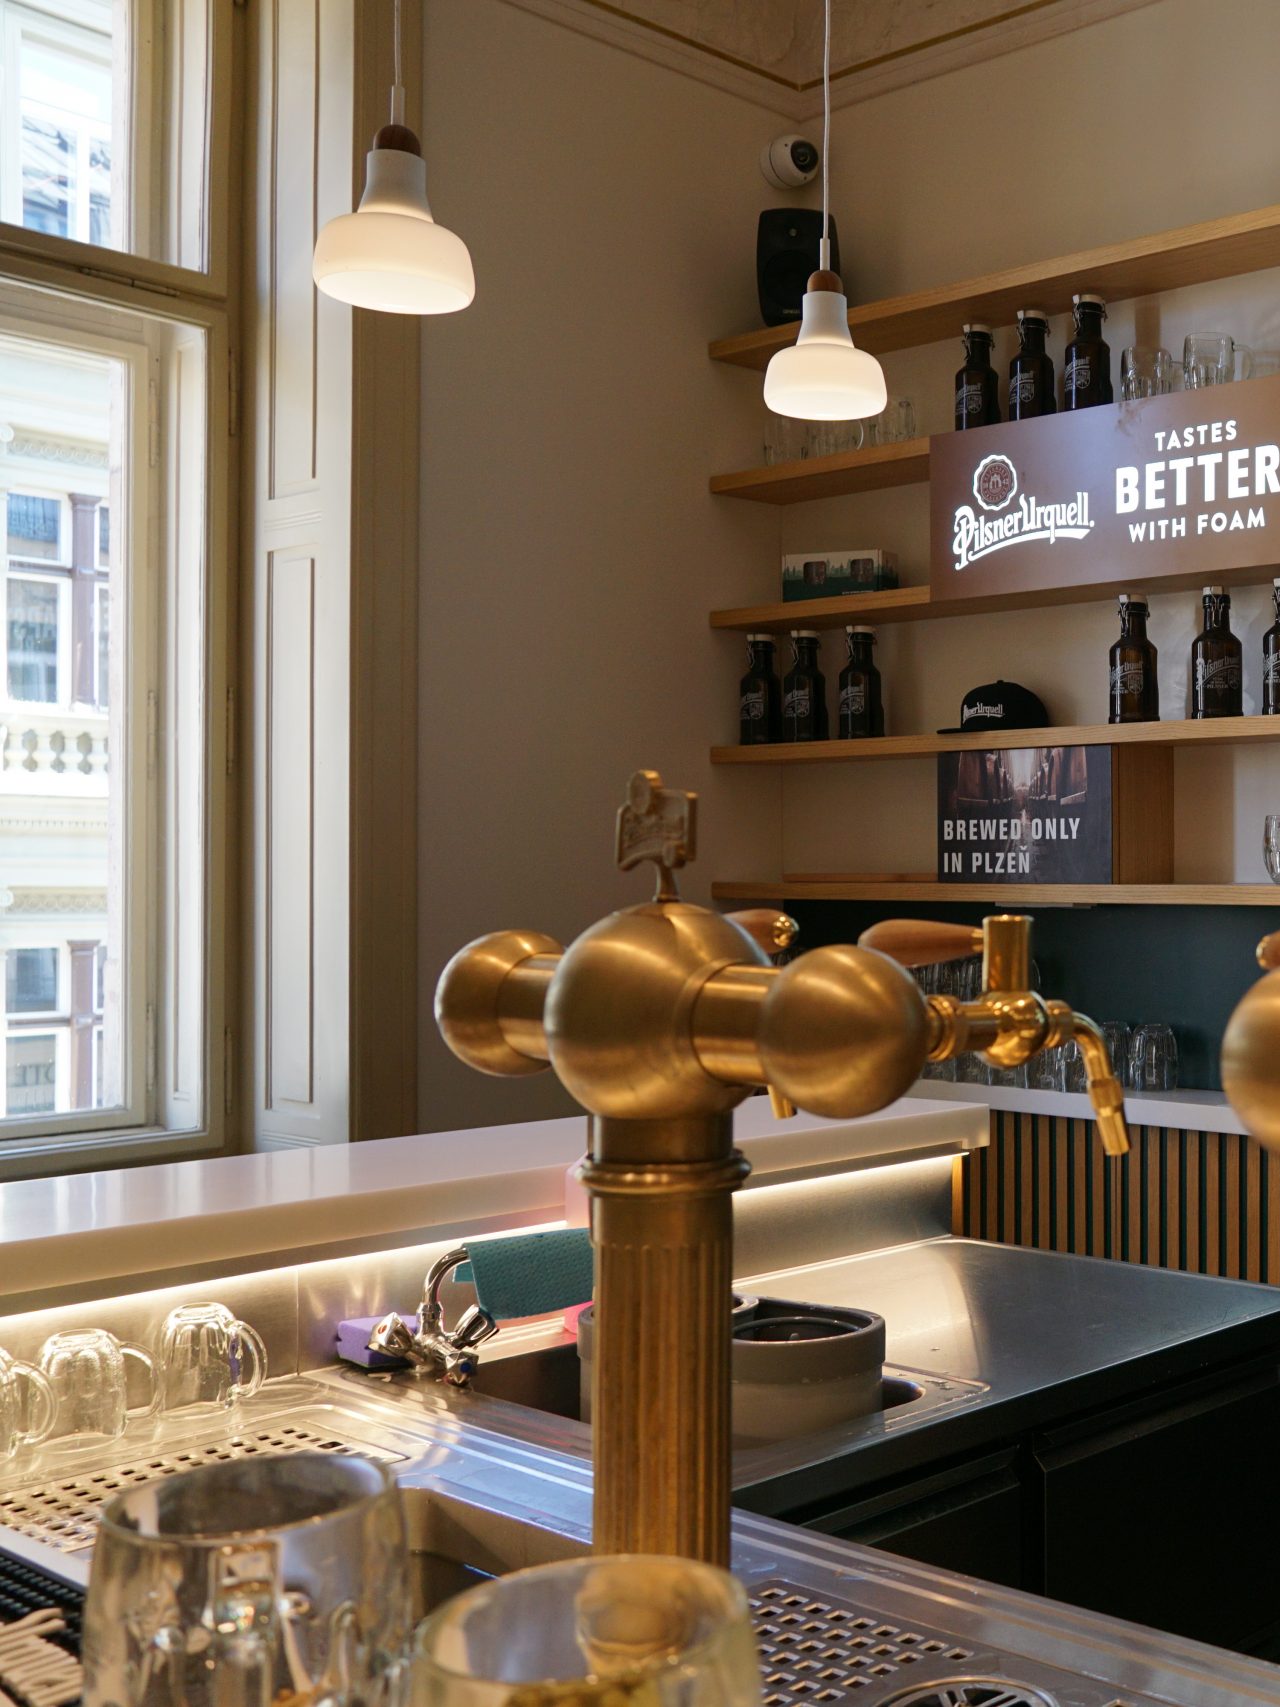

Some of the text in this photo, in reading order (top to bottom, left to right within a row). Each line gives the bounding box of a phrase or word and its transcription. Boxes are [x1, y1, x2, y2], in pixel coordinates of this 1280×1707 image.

[1154, 419, 1238, 453] TASTES
[952, 505, 1023, 571] Pilsner
[1128, 506, 1266, 543] WITH FOAM
[943, 817, 1081, 841] BREWED ONLY
[943, 845, 1030, 874] IN PLZEŇ
